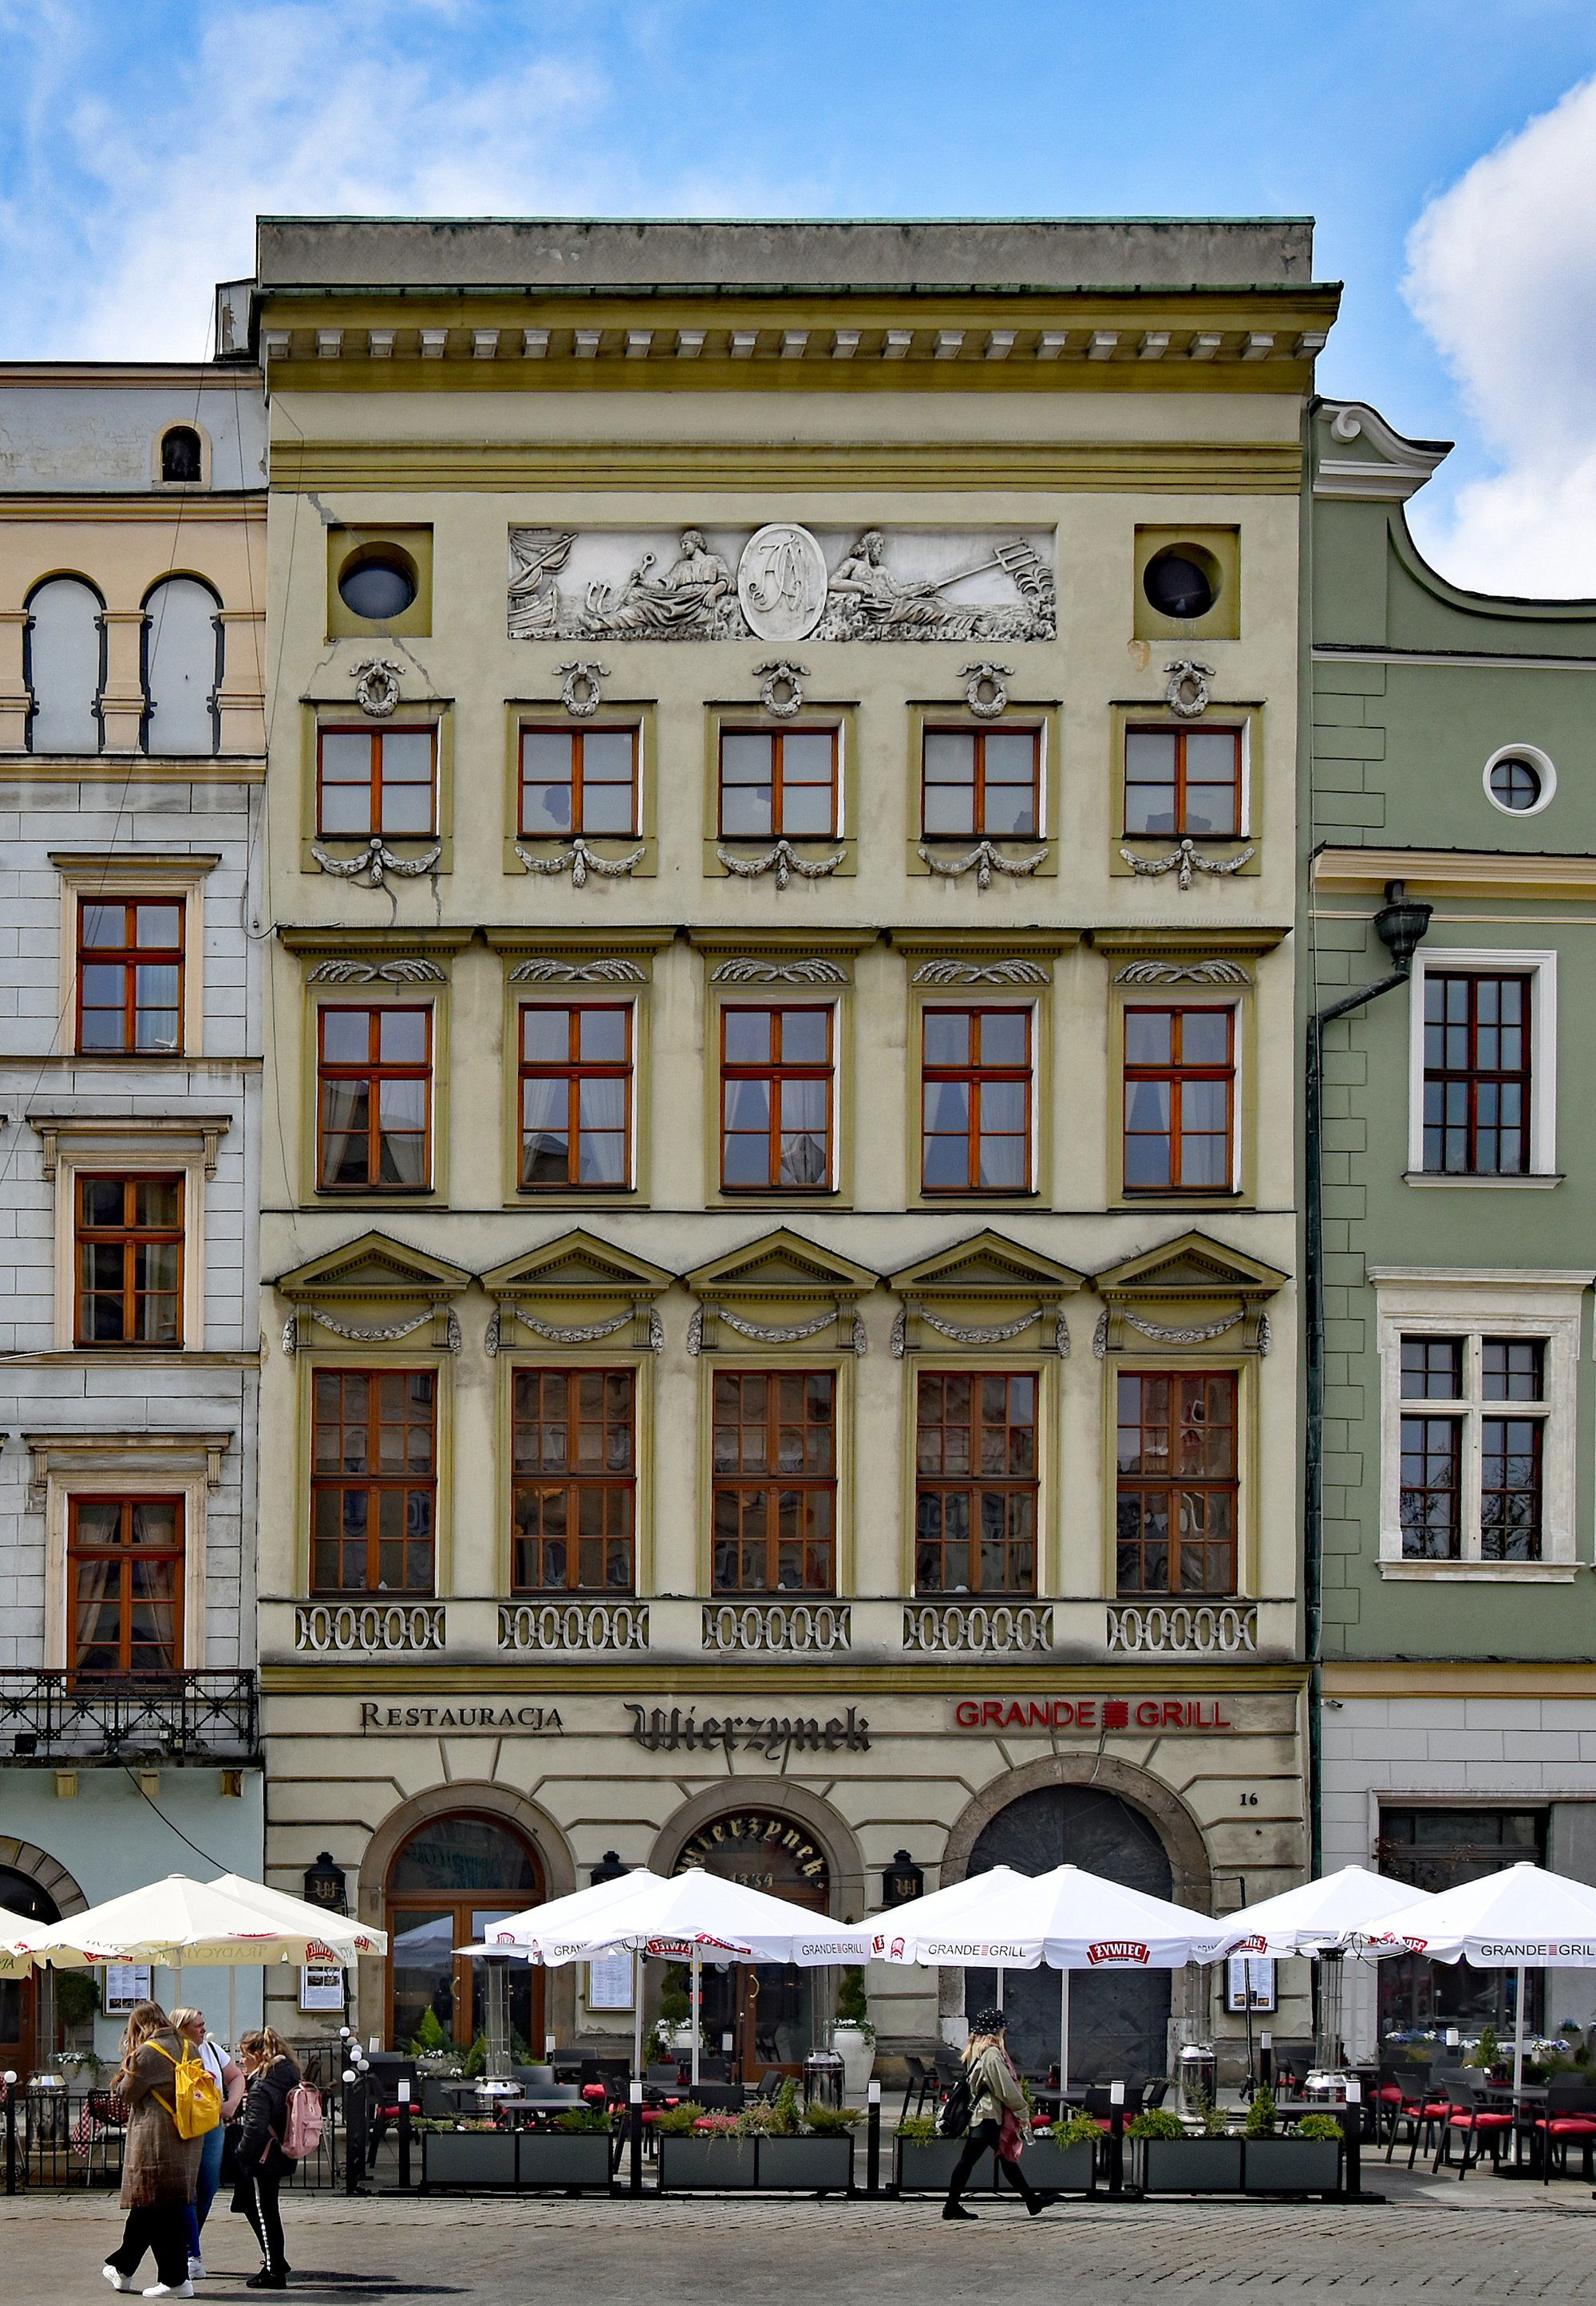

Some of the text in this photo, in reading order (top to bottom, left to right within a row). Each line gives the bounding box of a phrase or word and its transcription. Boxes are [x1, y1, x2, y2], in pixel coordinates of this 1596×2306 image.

[359, 1702, 564, 1731] RESTAURACJA
[956, 1701, 1231, 1728] GRANDE GRILL
[622, 1702, 872, 1760] Wierzynek
[1240, 1792, 1258, 1806] 16
[802, 1943, 836, 1956] GRANDE
[842, 1941, 864, 1954] GRILL
[928, 1944, 1027, 1957] GRANDE GRILL
[1094, 1943, 1143, 1957] ŻYWIEC
[1480, 1945, 1596, 1957] GRANDE GRIL
